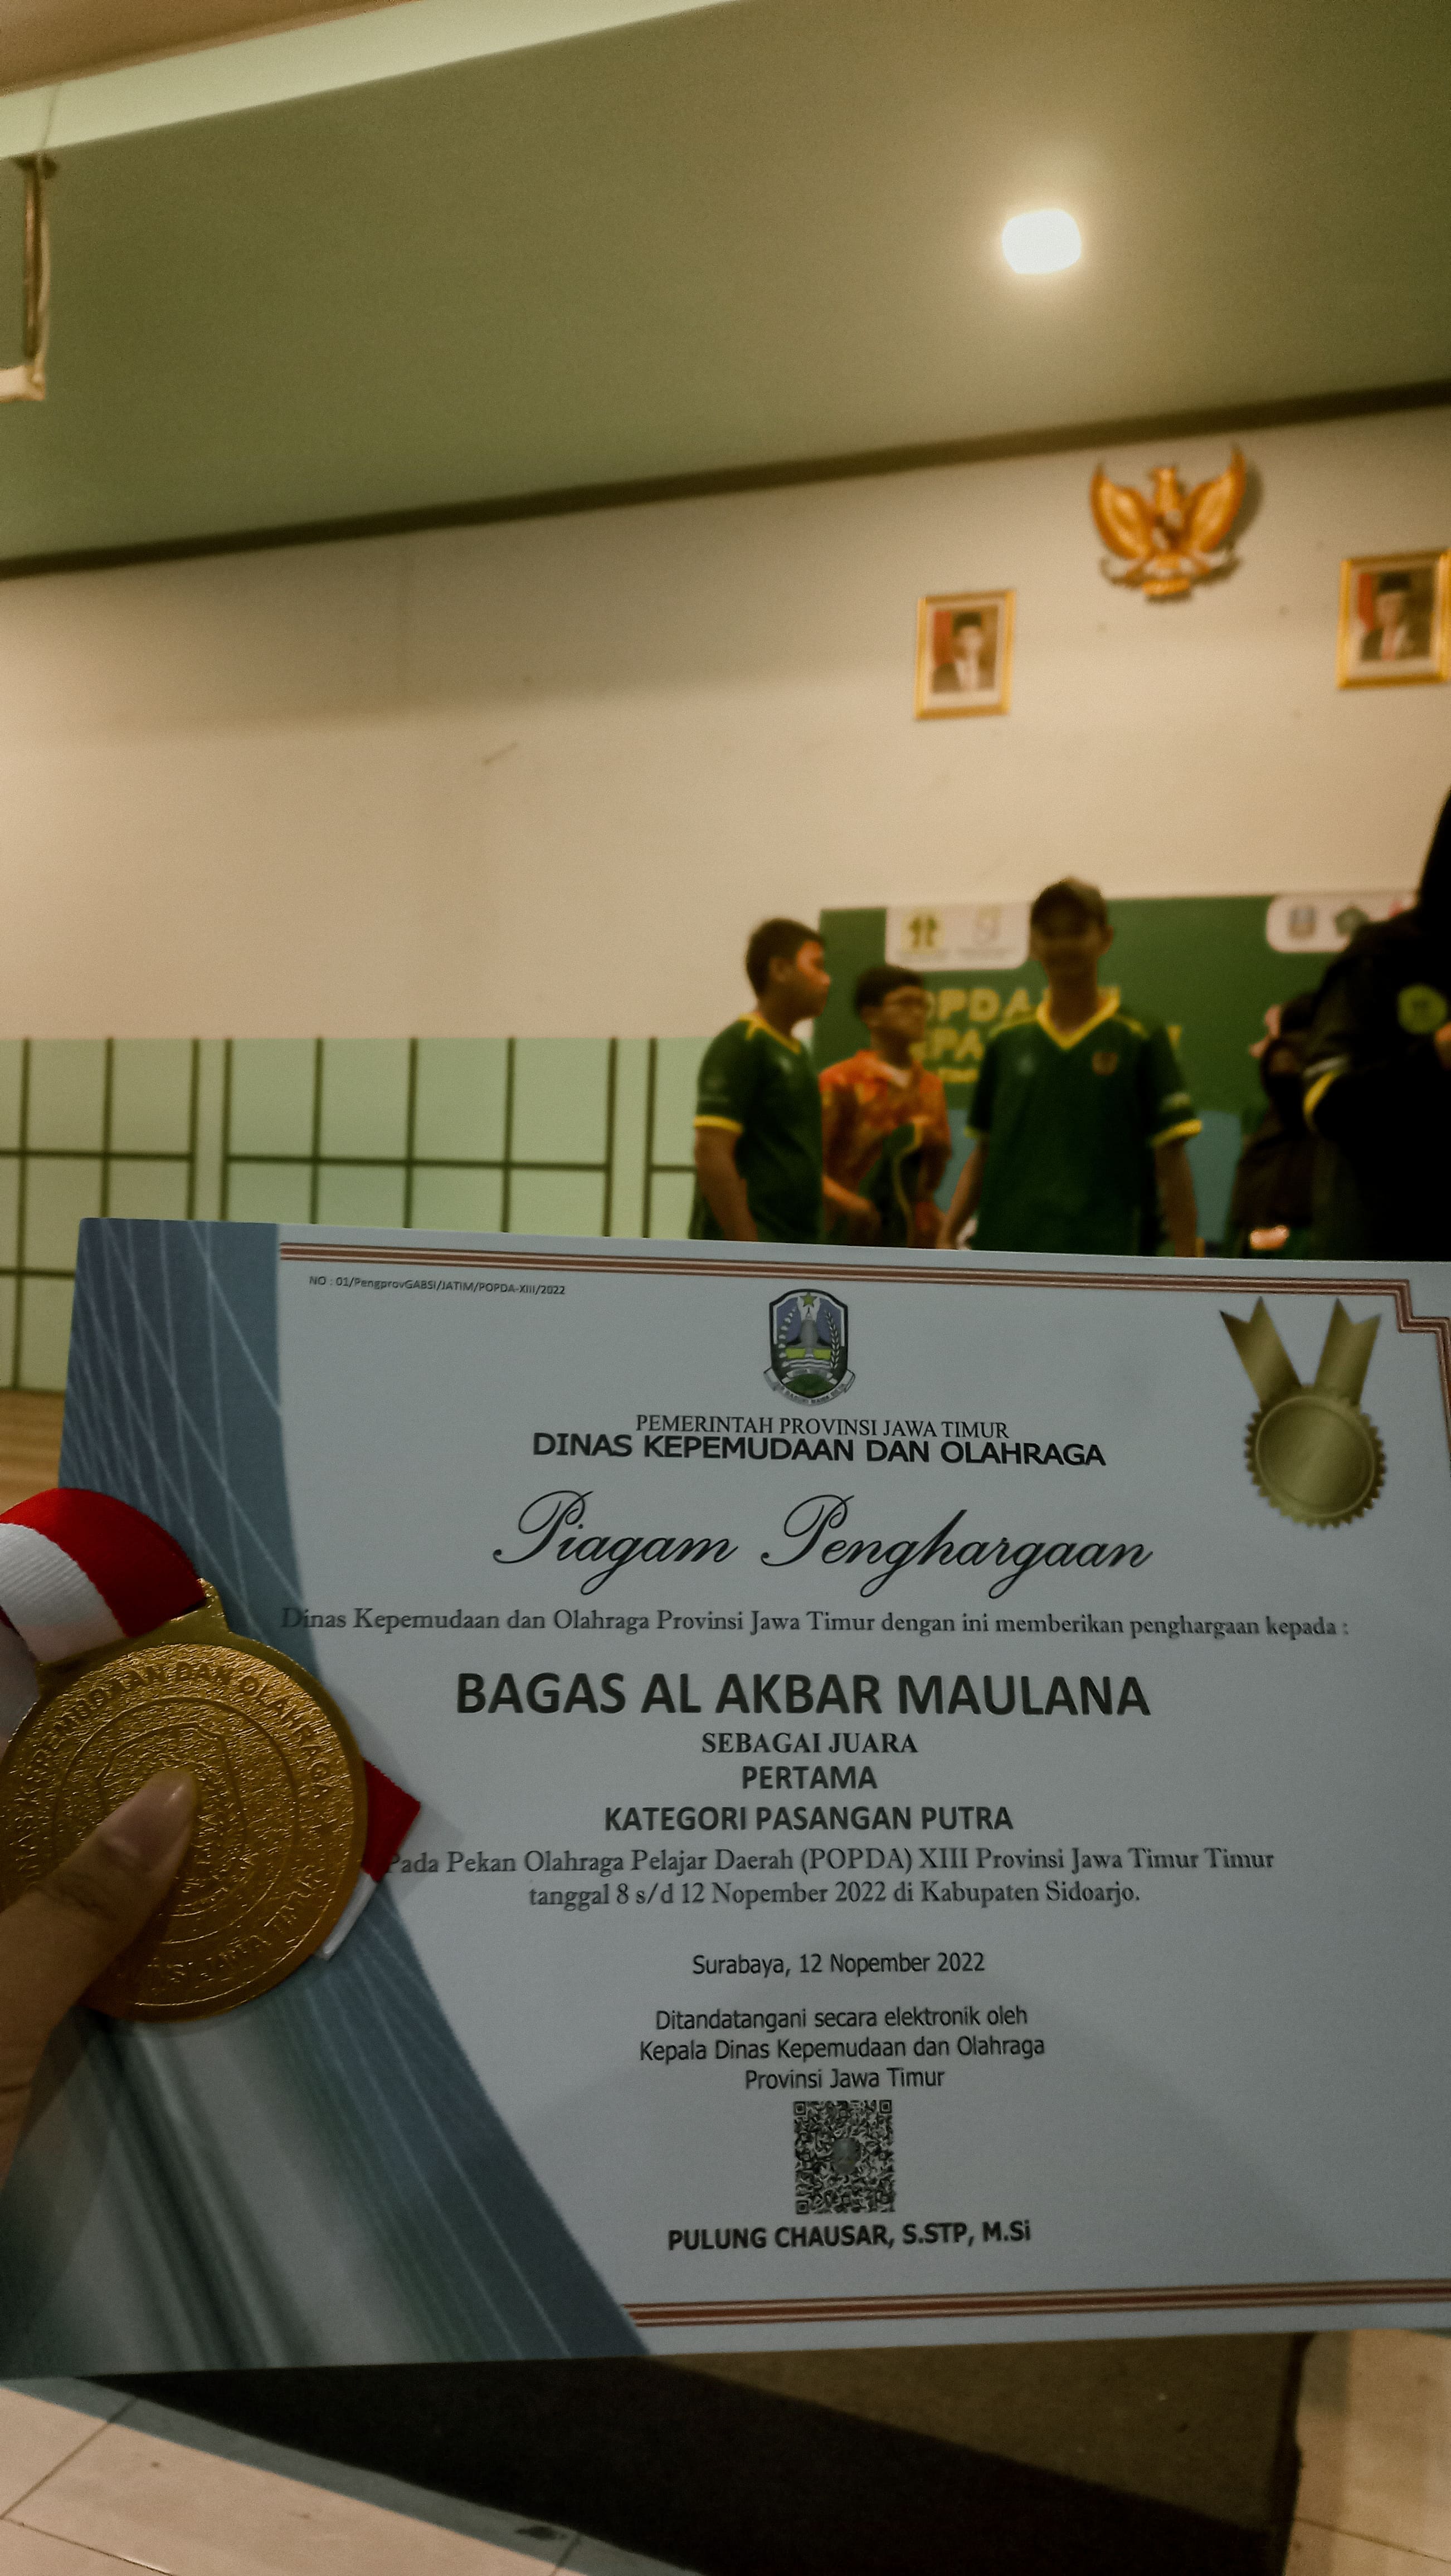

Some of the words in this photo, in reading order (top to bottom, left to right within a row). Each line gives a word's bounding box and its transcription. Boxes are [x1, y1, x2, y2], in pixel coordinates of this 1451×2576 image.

[309, 1275, 327, 1286] NO
[636, 1414, 772, 1433] PEMERINTAH
[779, 1417, 877, 1436] PROVINSI
[883, 1419, 938, 1437] JAWA
[941, 1421, 1010, 1439] TIMUR
[533, 1432, 633, 1458] DINAS
[644, 1435, 854, 1462] KEPEMUDAAN
[866, 1439, 930, 1463] DAN
[940, 1440, 1107, 1466] OLAHRAGA
[492, 1490, 739, 1596] Piagam
[760, 1494, 1153, 1600] Penghargaan
[281, 1607, 347, 1629] Dinas
[352, 1607, 500, 1635] Kepemudaan
[506, 1609, 546, 1629] dan
[553, 1609, 650, 1636] Olahraga
[656, 1609, 744, 1630] Provinsi
[749, 1610, 801, 1636] Jawa
[805, 1611, 875, 1631] Timur
[880, 1611, 956, 1637] dengan
[962, 1612, 989, 1632] ini
[995, 1613, 1124, 1633] memberikan
[1129, 1614, 1260, 1640] penghargaan
[1265, 1615, 1337, 1641] kepada
[456, 1672, 626, 1714] BAGAS
[640, 1672, 702, 1714] AL
[715, 1673, 883, 1715] AKBAR
[898, 1674, 1152, 1716] MAULANA
[702, 1732, 821, 1754] SEBAGAI
[828, 1732, 919, 1754] JUARA
[742, 1765, 878, 1790] PERTAMA
[605, 1806, 747, 1832] KATEGORI
[756, 1806, 912, 1831] PASANGAN
[921, 1806, 1014, 1831] PUTRA
[445, 1851, 517, 1873] Pekan
[523, 1850, 625, 1878] Olahraga
[630, 1848, 708, 1877] Pelajar
[714, 1848, 794, 1870] Daerah
[800, 1847, 913, 1875] (POPDA)
[918, 1847, 968, 1869] XIII
[975, 1847, 1065, 1869] Provinsi
[1071, 1847, 1123, 1875] Jawa
[1127, 1847, 1199, 1869] Timur
[1203, 1847, 1275, 1869] Timur
[528, 1882, 610, 1912] tanggal
[616, 1882, 630, 1905] 8
[635, 1882, 674, 1905] s/d
[681, 1882, 705, 1904] 12
[711, 1881, 829, 1910] Nopember
[835, 1880, 887, 1903] 2022
[893, 1880, 914, 1902] di
[920, 1880, 1040, 1909] Kabupaten
[1045, 1880, 1140, 1908] Sidoarjo.
[692, 1954, 791, 1979] Surabaya,
[800, 1953, 823, 1974] 12
[830, 1951, 931, 1978] Nopember
[937, 1951, 986, 1973] 2022
[655, 2008, 807, 2034] Ditandatangani
[814, 2011, 878, 2028] secara
[884, 2005, 981, 2027] elektronik
[986, 2004, 1028, 2026] oleh
[640, 2039, 708, 2066] Kepala
[714, 2039, 771, 2060] Dinas
[777, 2036, 907, 2063] Kepemudaan
[913, 2035, 950, 2057] dan
[956, 2035, 1045, 2061] Olahraga
[745, 2068, 822, 2090] Provinsi
[829, 2067, 880, 2089] Jawa
[885, 2066, 946, 2087] Timur
[668, 2227, 767, 2251] PULUNG
[774, 2224, 895, 2250] CHAUSAR,
[902, 2221, 975, 2247] S.STP,
[981, 2219, 1031, 2243] M.Si
